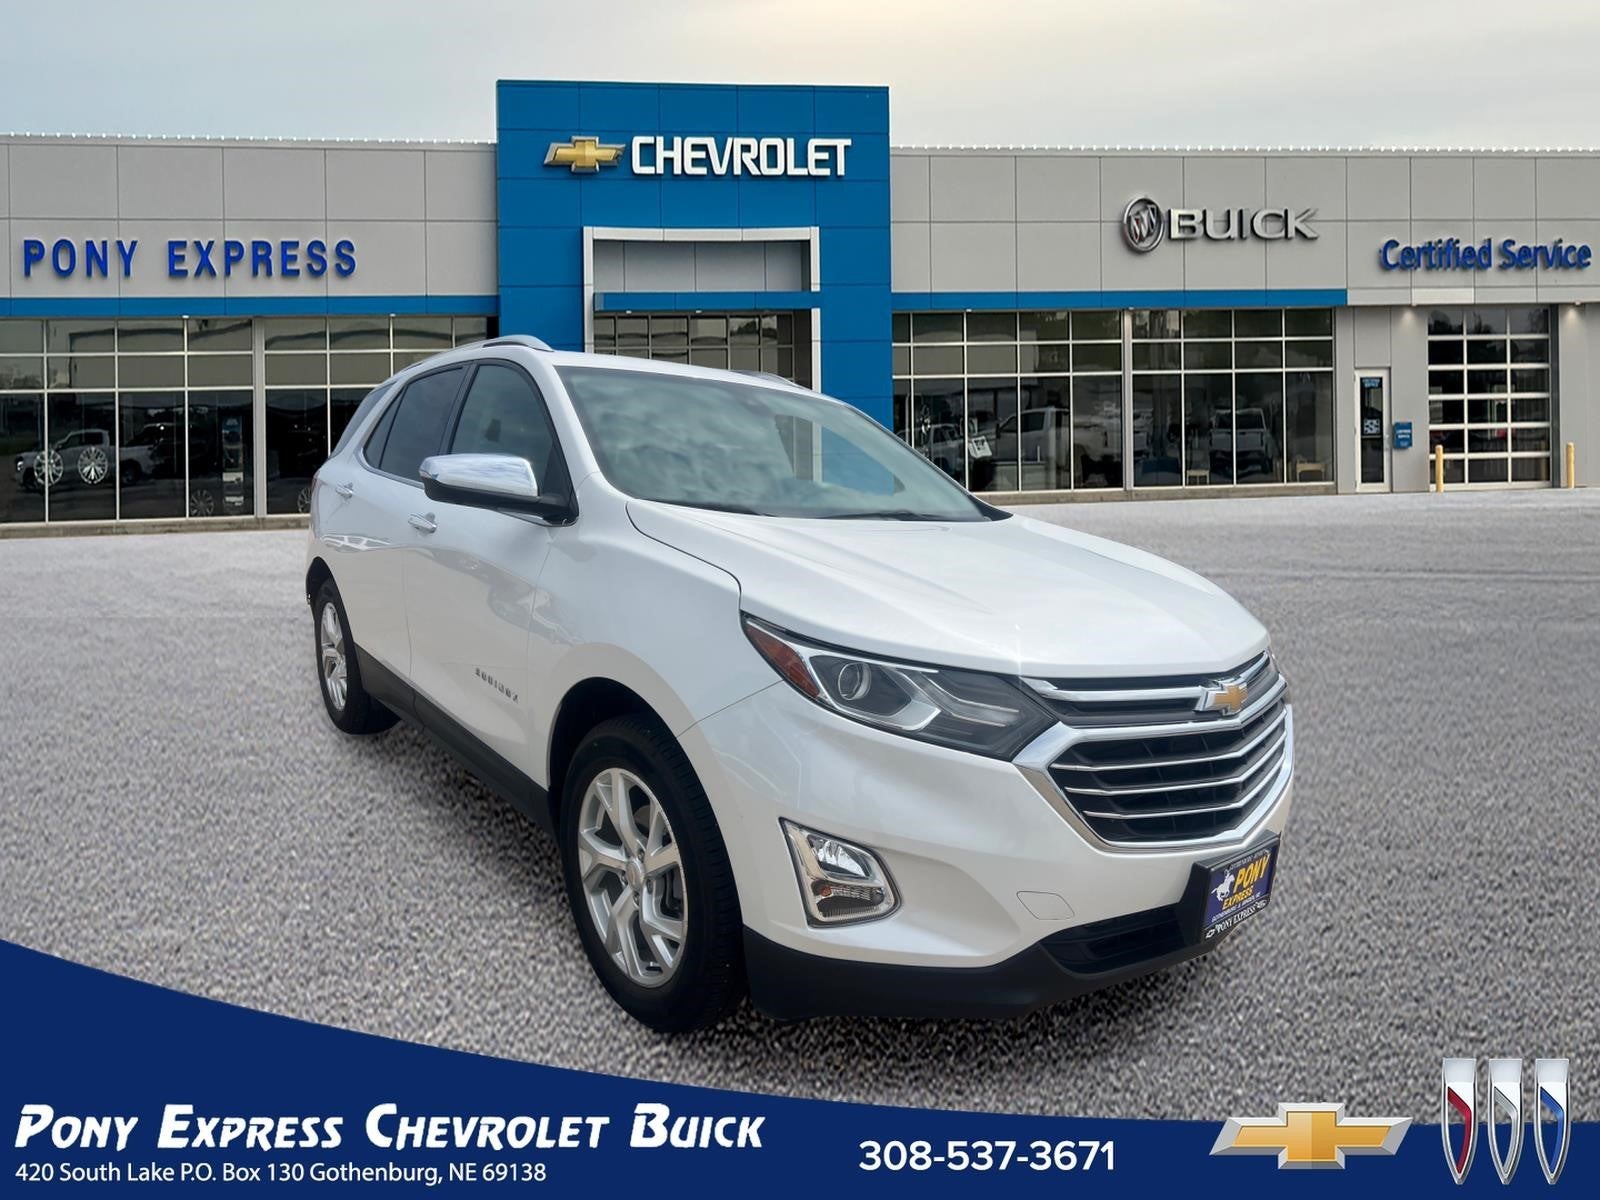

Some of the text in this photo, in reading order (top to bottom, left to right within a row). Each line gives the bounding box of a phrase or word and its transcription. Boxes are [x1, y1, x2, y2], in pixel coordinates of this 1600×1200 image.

[631, 135, 852, 176] CHEVROLET
[1168, 208, 1319, 240] BUICK
[23, 239, 357, 278] PONY EXPRESS
[1382, 239, 1592, 270] Certified Service
[1233, 854, 1270, 893] PONY
[1222, 886, 1254, 910] EXPRESS
